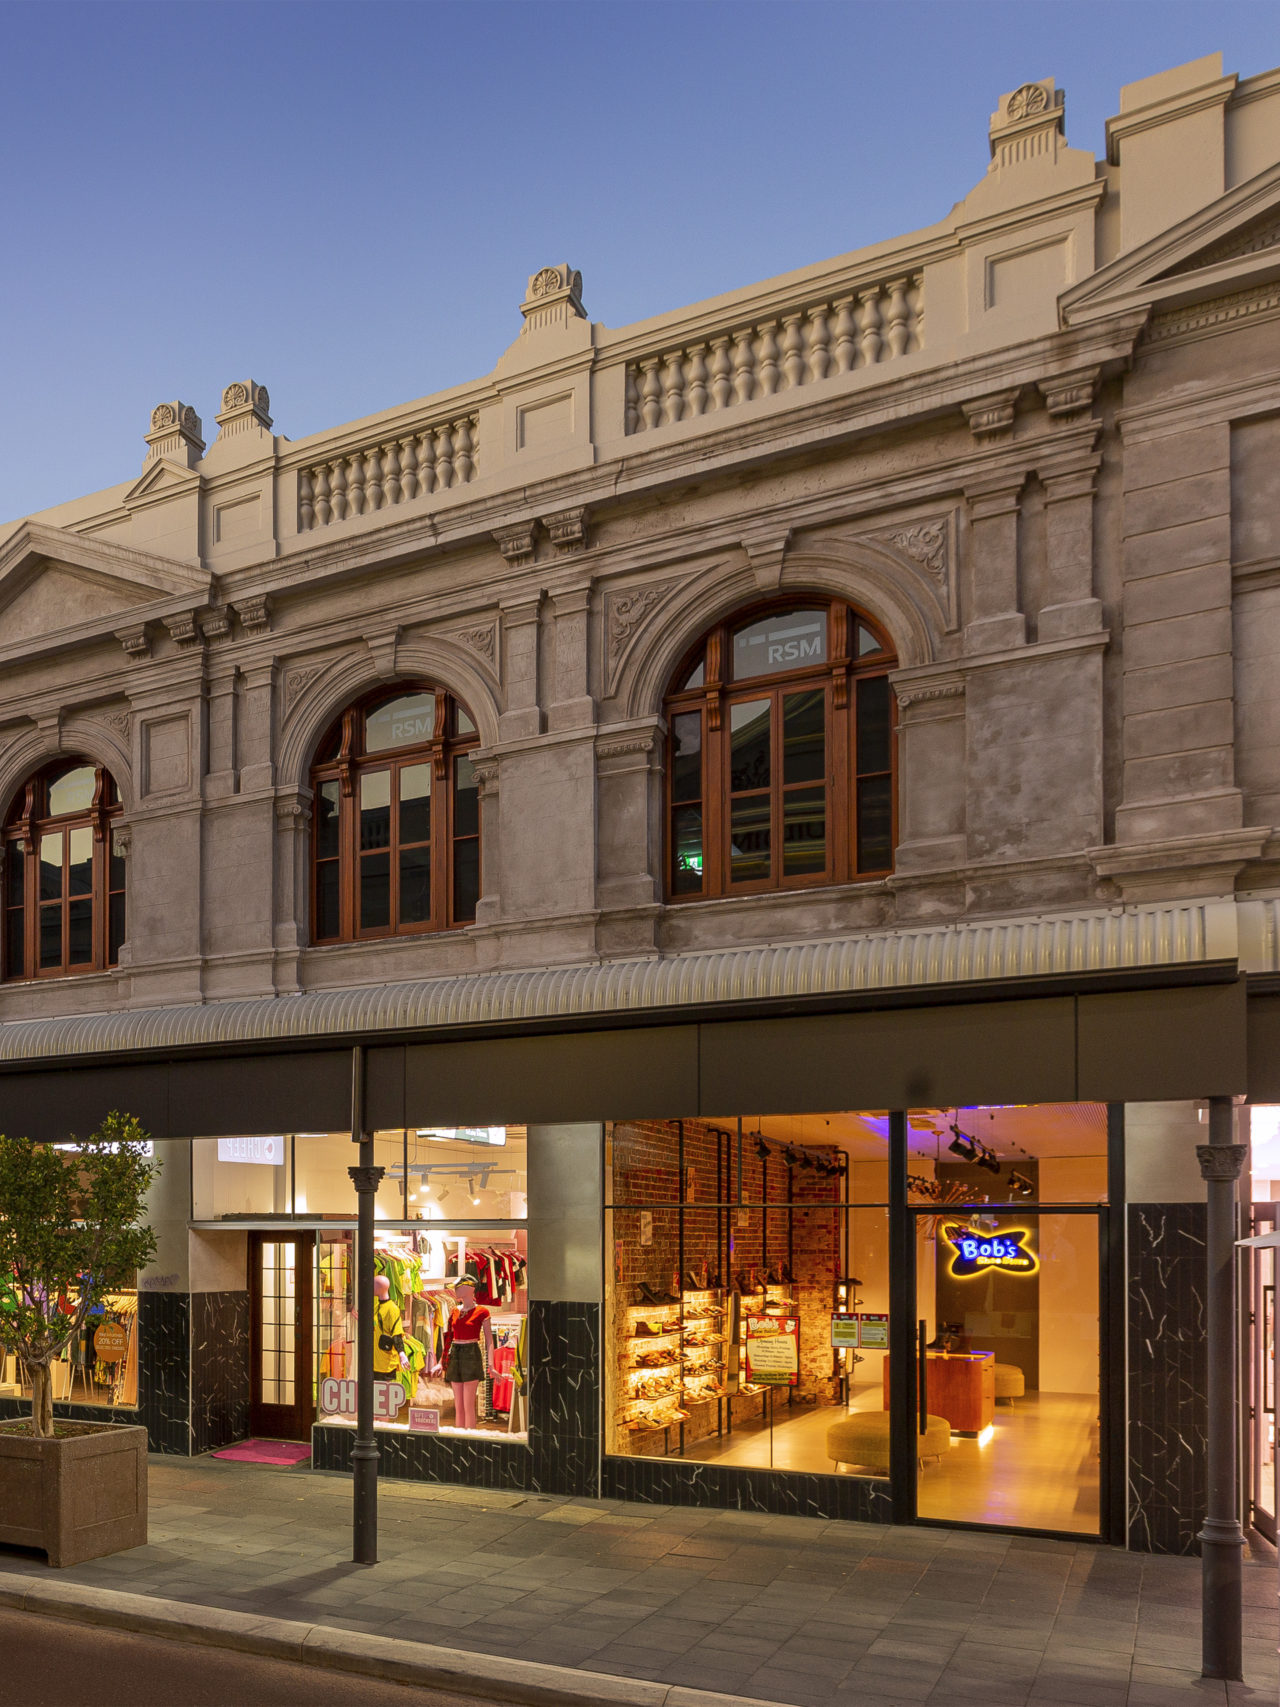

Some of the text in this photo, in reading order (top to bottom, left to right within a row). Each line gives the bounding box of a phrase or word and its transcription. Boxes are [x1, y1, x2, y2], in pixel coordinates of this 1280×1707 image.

[768, 636, 821, 664] RSM
[391, 717, 432, 739] RSM
[962, 1239, 1018, 1258] Bob's
[111, 1338, 124, 1346] OFF
[323, 1378, 405, 1418] CHEP
